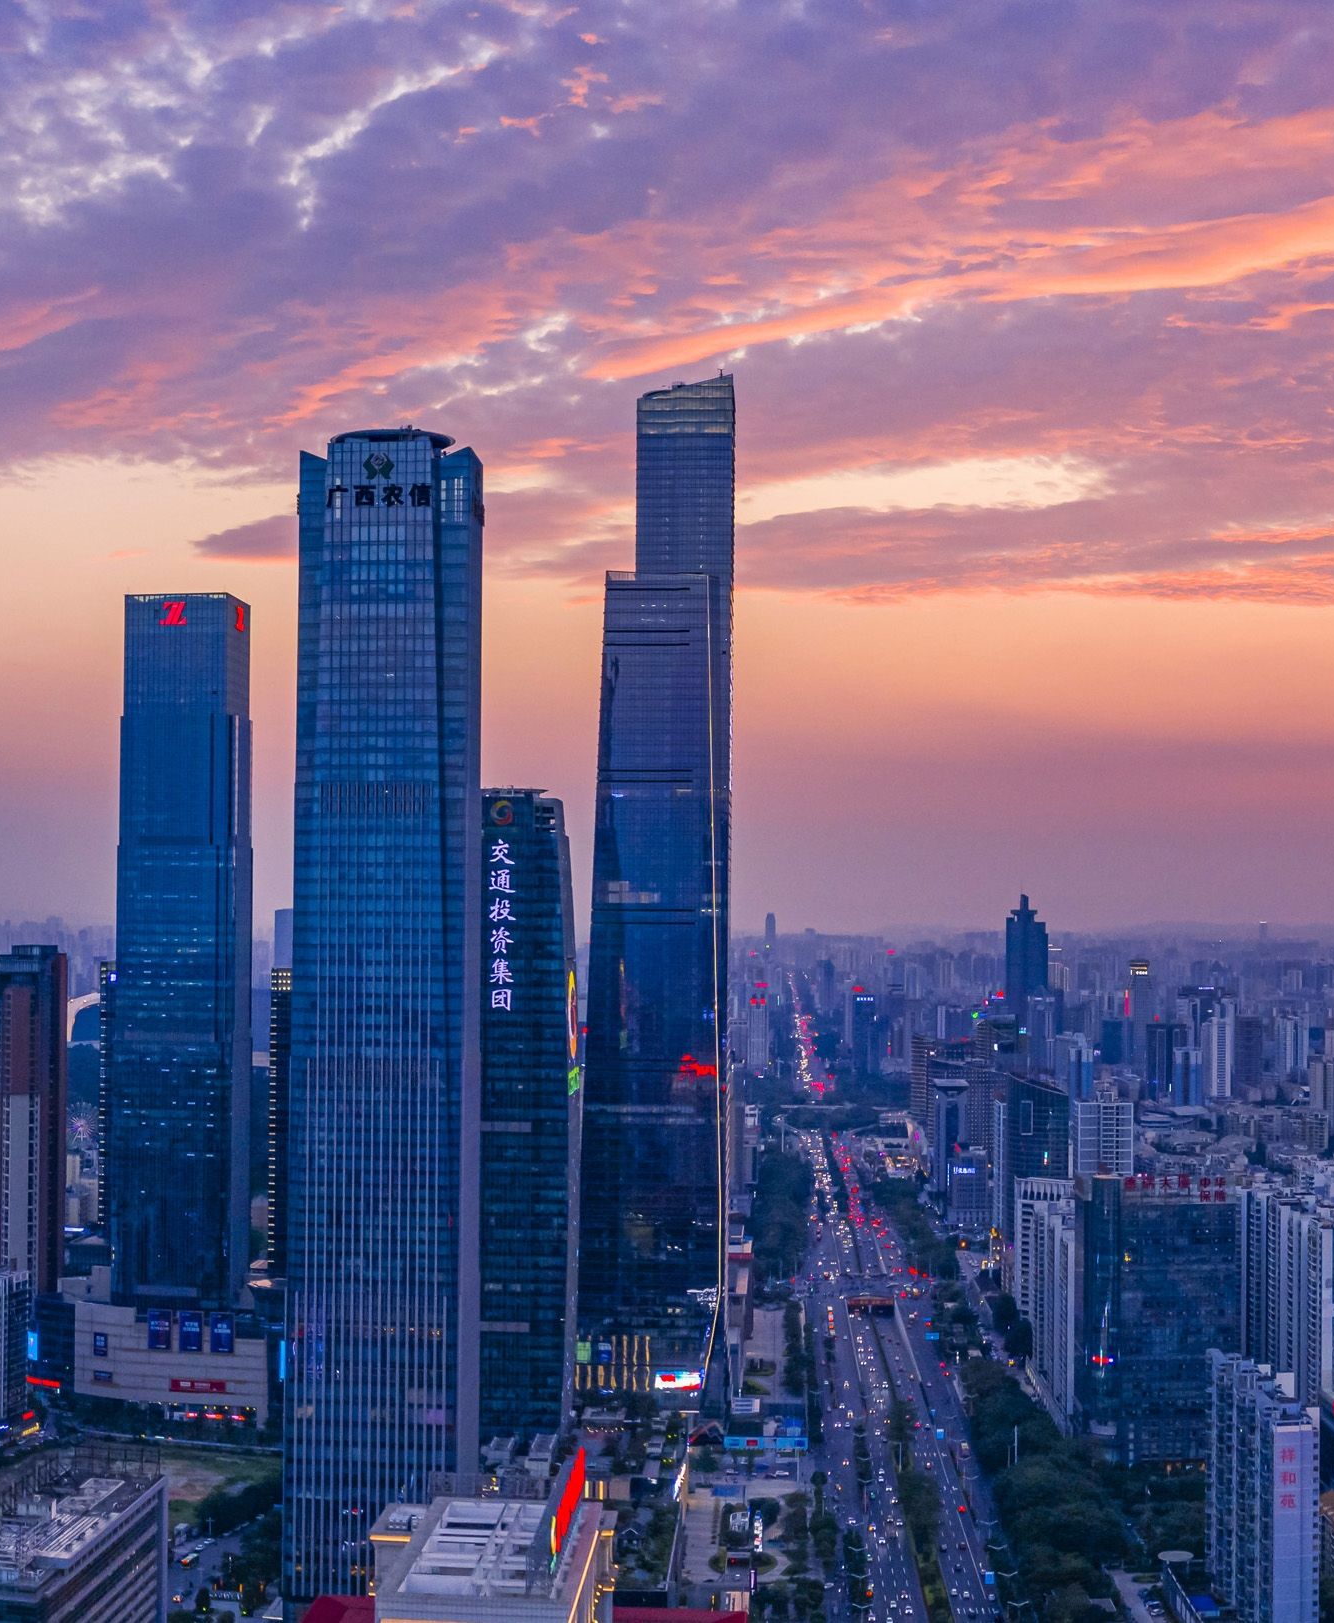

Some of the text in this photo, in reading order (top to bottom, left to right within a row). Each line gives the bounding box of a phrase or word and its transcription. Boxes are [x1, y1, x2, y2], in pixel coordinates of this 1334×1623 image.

[326, 483, 432, 508] 广西农信
[488, 838, 517, 1011] 交通投资集团
[1279, 1446, 1297, 1509] 祥和苑
